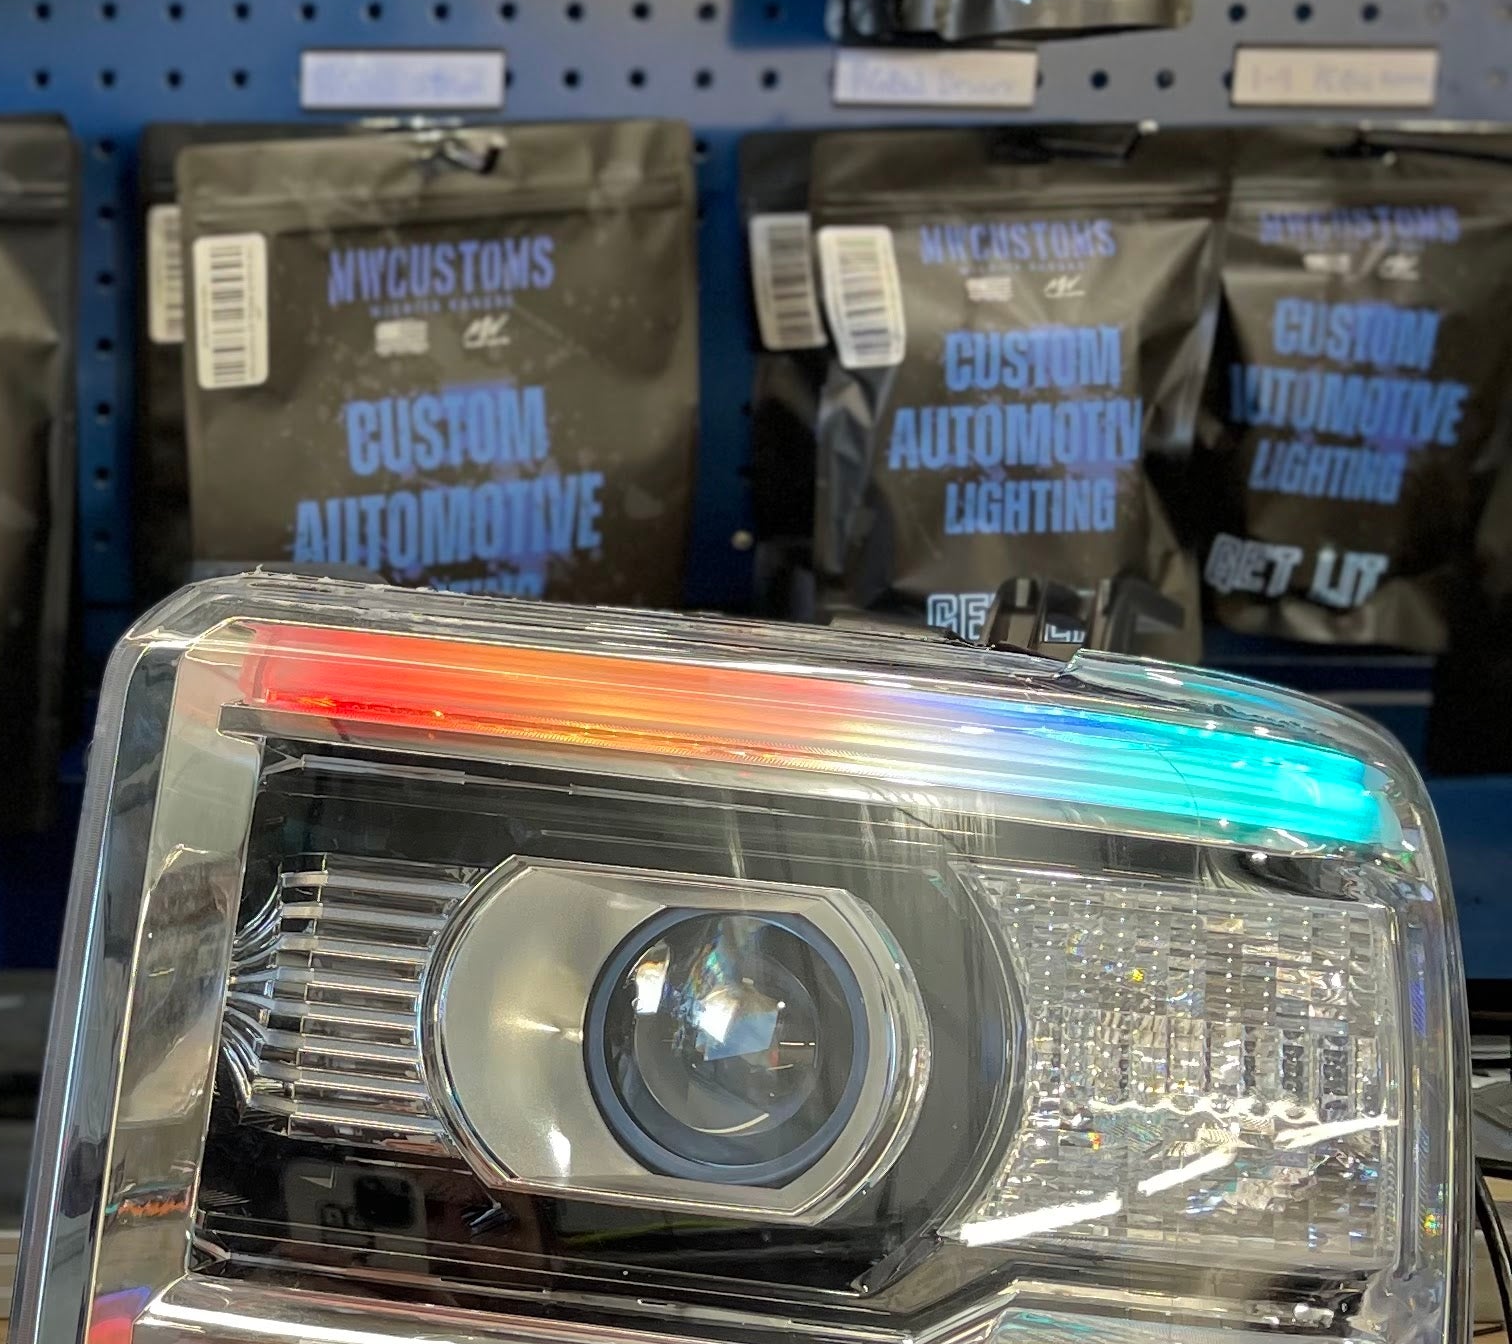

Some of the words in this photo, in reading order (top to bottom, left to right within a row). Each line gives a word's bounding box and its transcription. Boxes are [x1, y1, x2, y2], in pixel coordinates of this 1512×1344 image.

[328, 235, 555, 305] MWCUSTOMS
[920, 218, 1117, 264] MWCUSTOMS
[944, 324, 1122, 391] CUSTOM
[1273, 296, 1441, 370] CUSTOM
[345, 385, 551, 476] CUSTOM
[888, 397, 1142, 469] AUTOMOTIV
[944, 477, 1116, 535] LIGHTING
[1249, 438, 1408, 505] LIGHTING
[293, 471, 605, 572] AUTOMOTIVE
[1204, 532, 1304, 596] GET
[1309, 544, 1388, 608] LIT
